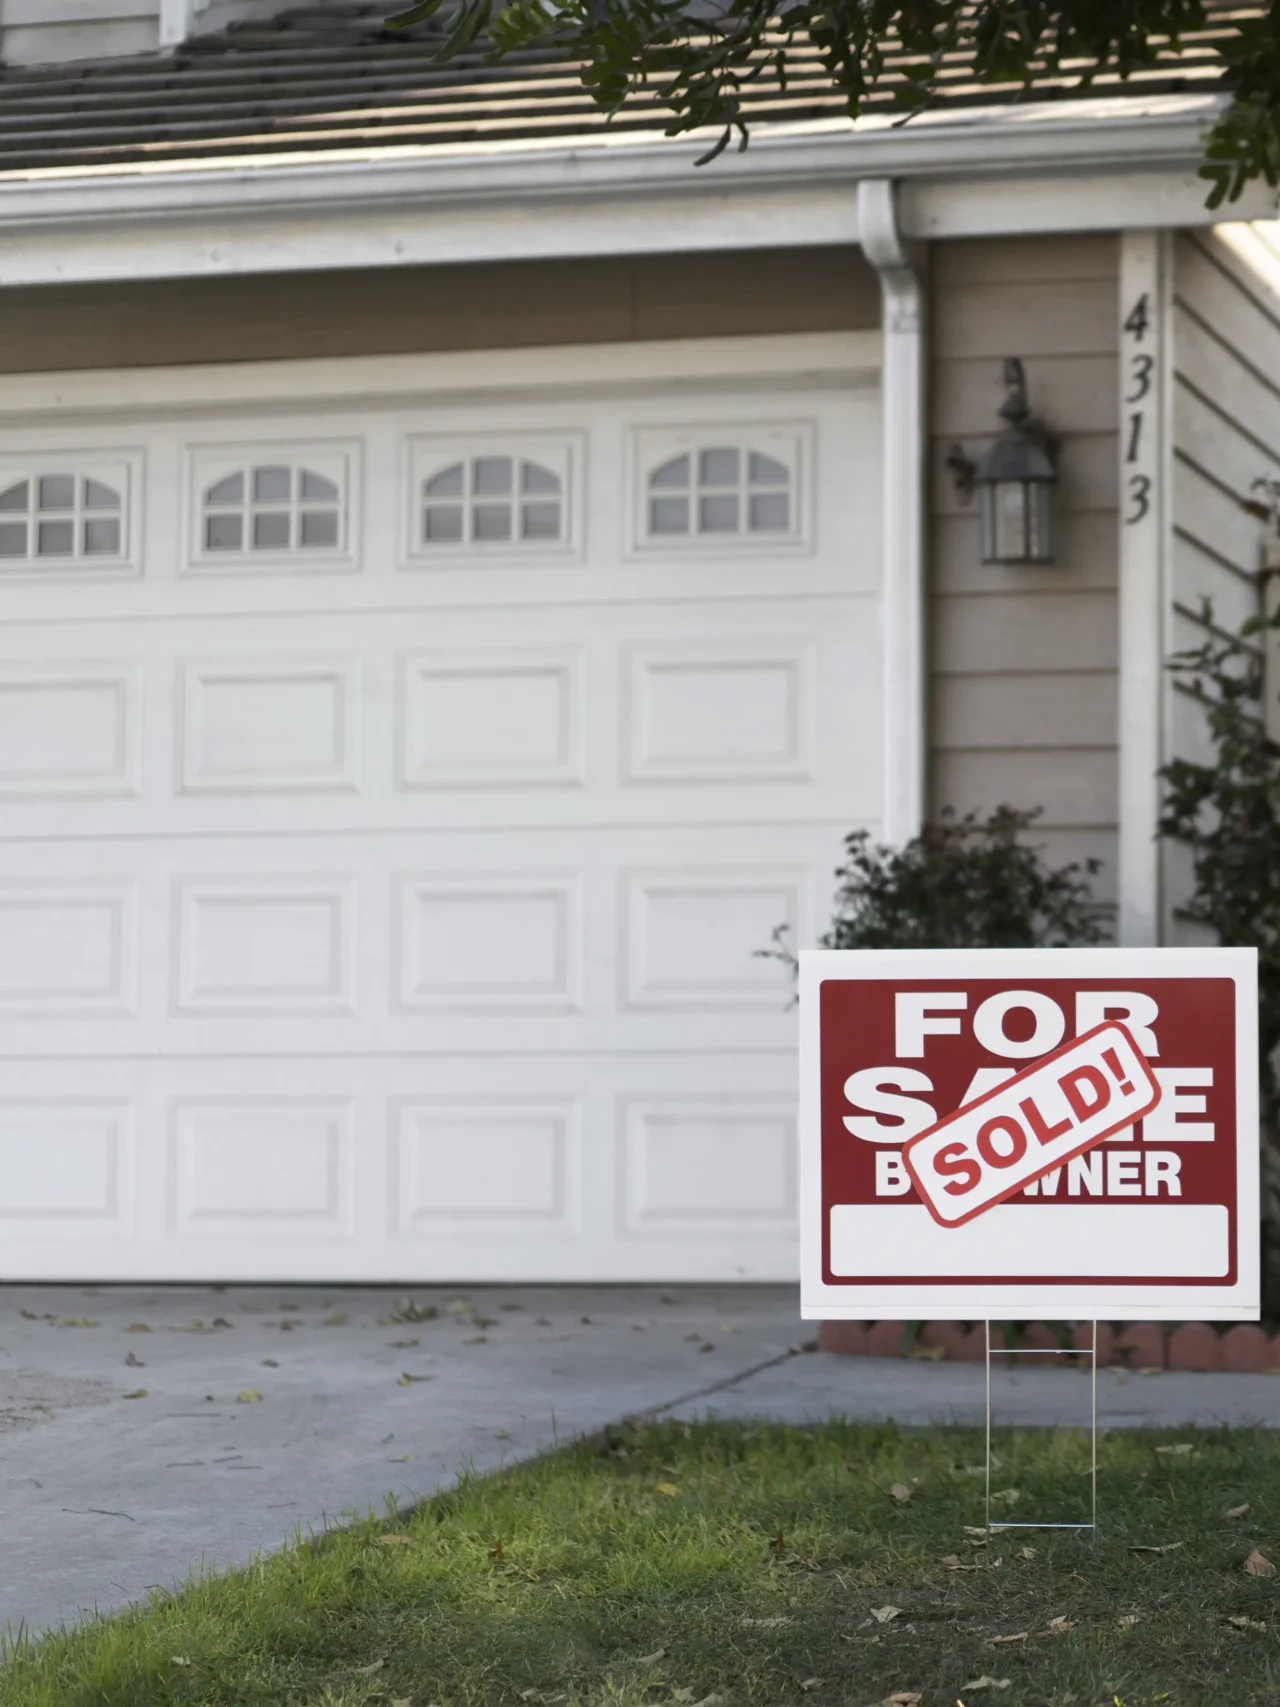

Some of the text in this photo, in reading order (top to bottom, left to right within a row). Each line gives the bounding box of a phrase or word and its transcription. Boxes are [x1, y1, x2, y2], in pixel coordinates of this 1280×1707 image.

[1124, 292, 1154, 526] 4313
[895, 990, 1160, 1058] FOR
[842, 1066, 1215, 1143] SE
[933, 1047, 1136, 1196] SOLD!
